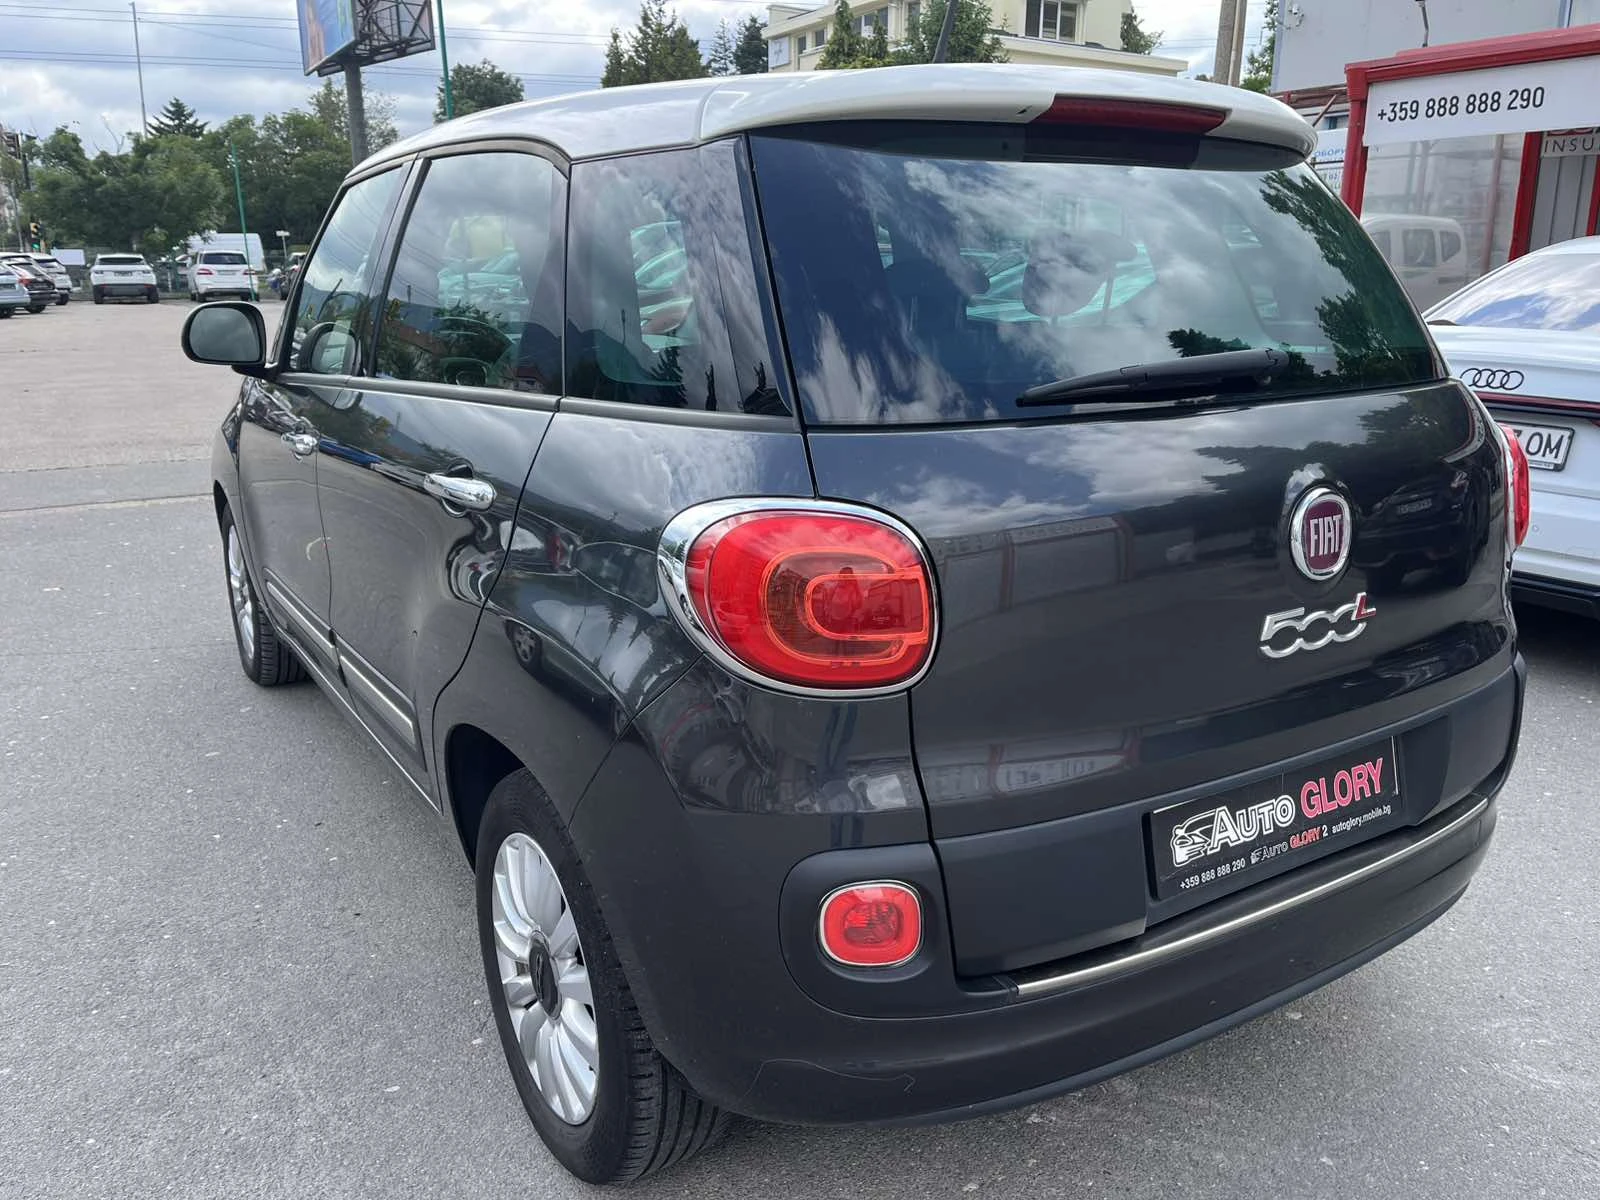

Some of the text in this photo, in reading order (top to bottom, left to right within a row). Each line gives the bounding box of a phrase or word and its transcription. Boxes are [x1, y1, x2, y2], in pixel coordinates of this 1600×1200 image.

[1377, 86, 1545, 122] +359 888 888 290
[1544, 137, 1600, 153] INSU
[1310, 514, 1342, 558] FIAT
[1206, 757, 1384, 854] AUTO GLORY
[1180, 804, 1392, 889] +359 888 888 290 AUTO GLORY 2 autoglory.mobile.bg
